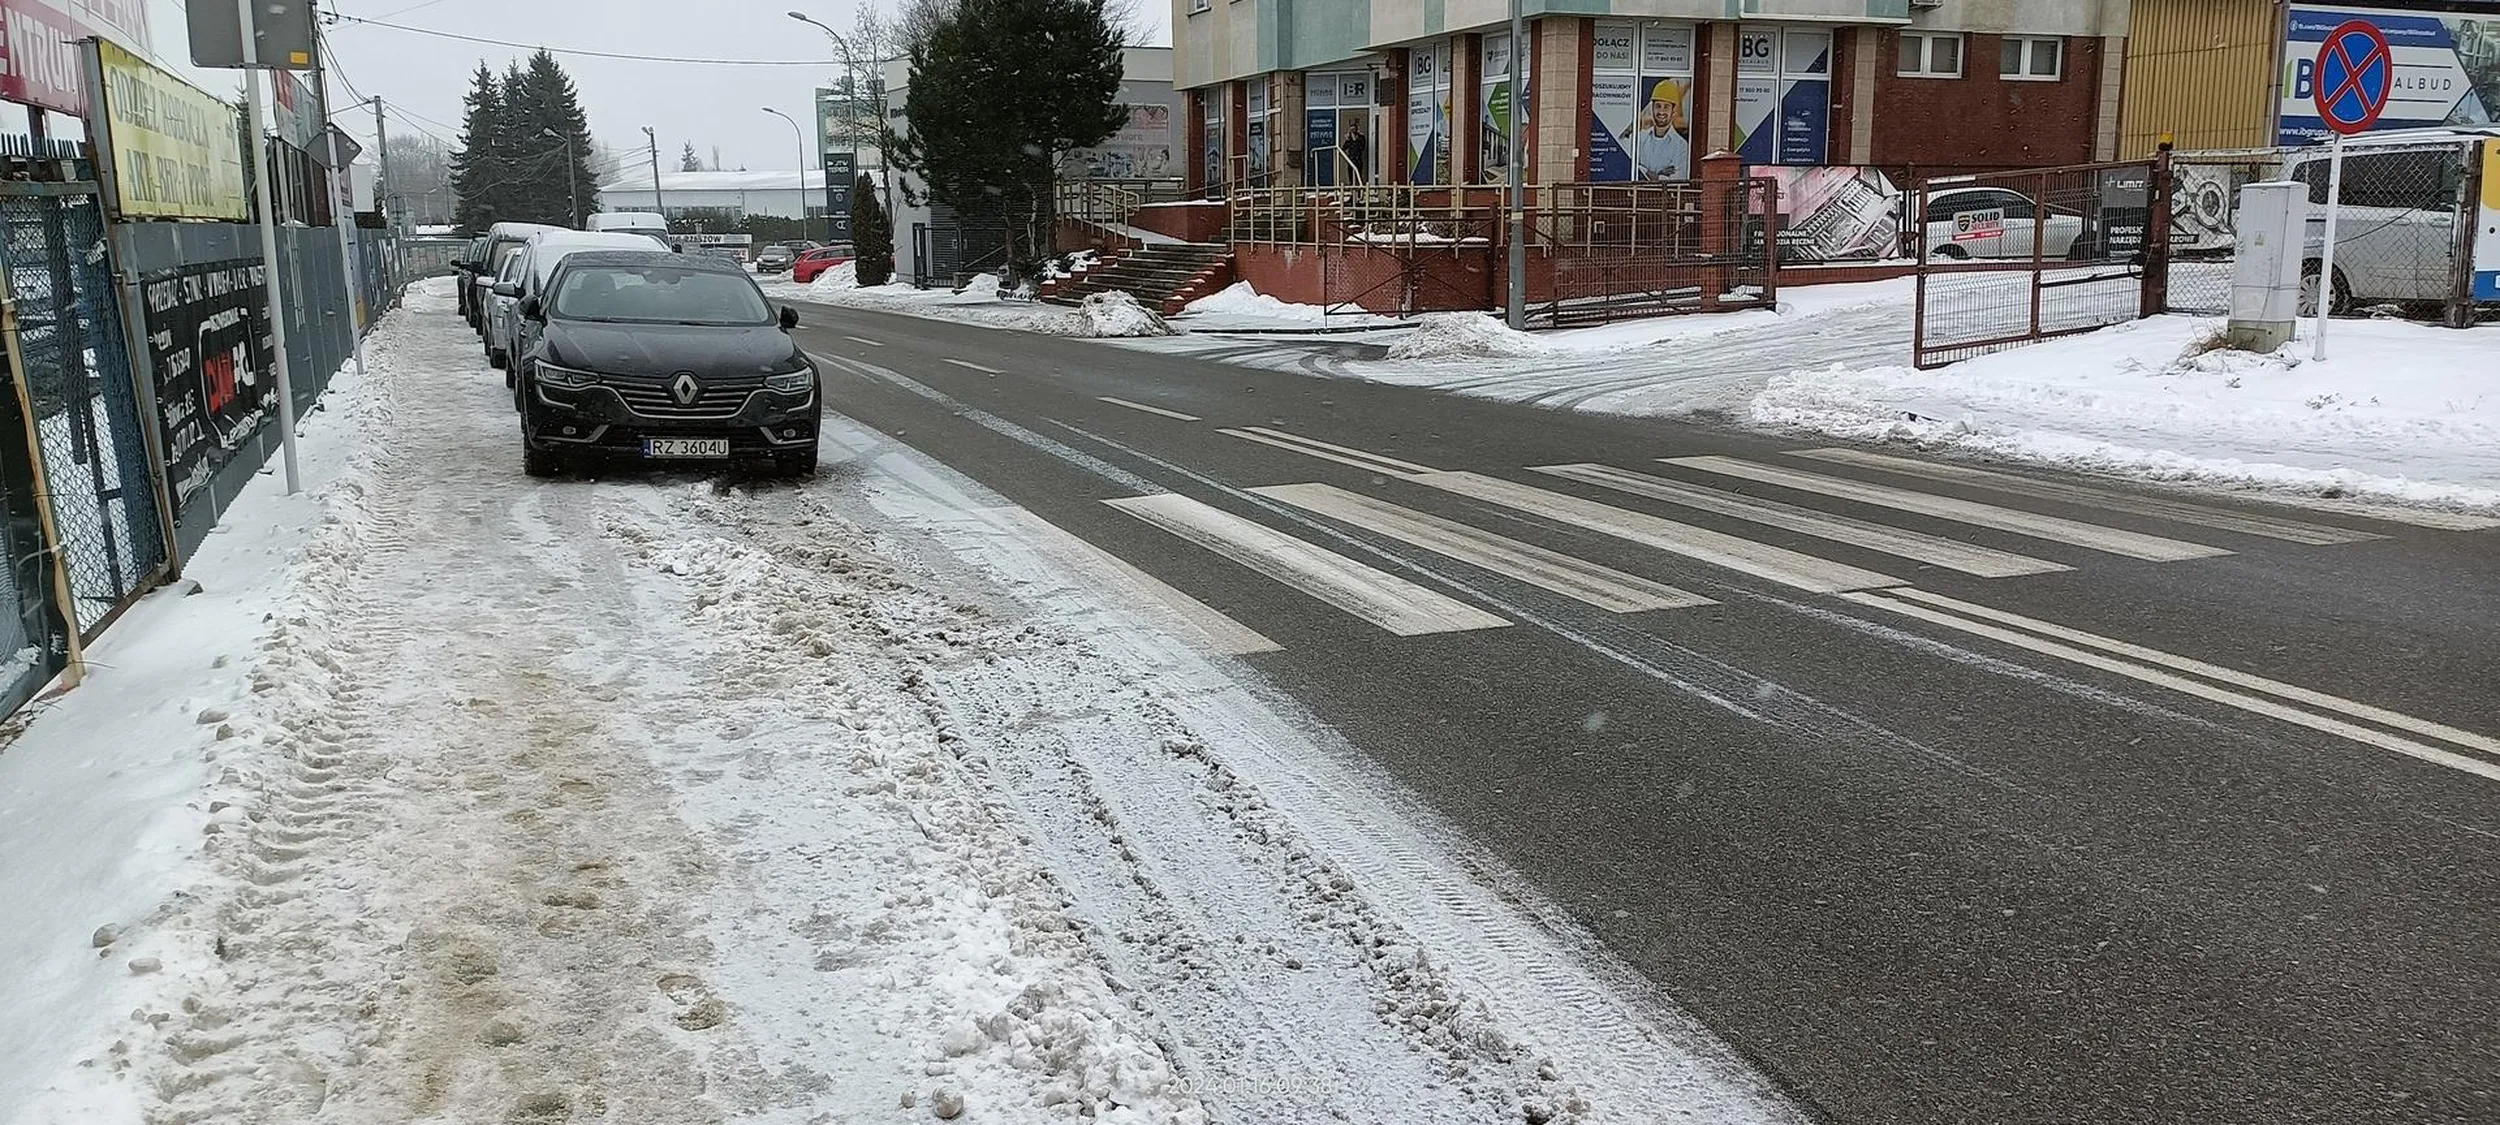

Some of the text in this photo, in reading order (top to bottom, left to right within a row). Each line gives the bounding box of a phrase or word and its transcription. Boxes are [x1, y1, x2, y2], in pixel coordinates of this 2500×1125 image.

[1972, 212, 2000, 223] SOLID
[653, 440, 727, 454] RZ 3604U
